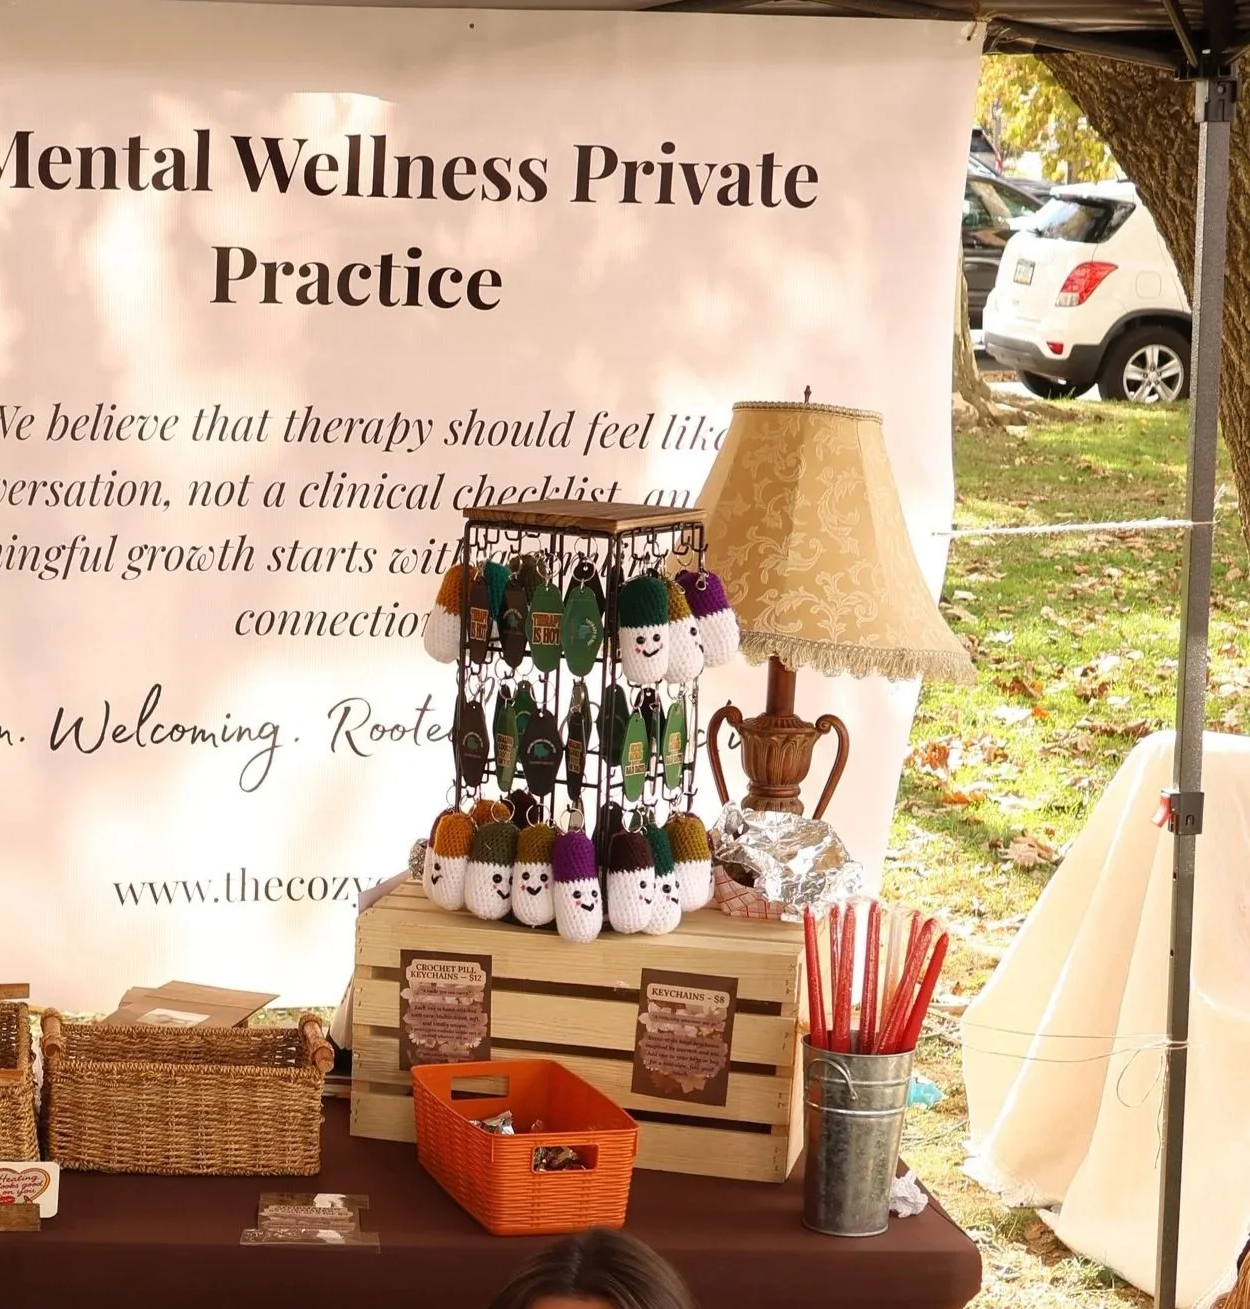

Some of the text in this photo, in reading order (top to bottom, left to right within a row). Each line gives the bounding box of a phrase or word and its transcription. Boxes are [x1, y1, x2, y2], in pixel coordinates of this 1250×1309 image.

[230, 134, 548, 203] Wellness
[570, 141, 818, 209] Private
[210, 246, 502, 311] Practice
[46, 402, 179, 441] believe
[192, 404, 272, 442] that
[284, 405, 433, 453] therapy
[444, 408, 576, 448] should
[583, 410, 655, 456] feel
[188, 474, 254, 507] not
[263, 481, 286, 508] a
[299, 470, 446, 511] clinical
[122, 534, 254, 580] growth
[267, 540, 377, 573] starts
[50, 683, 299, 793] Welcoming.
[327, 693, 454, 757] Roote
[410, 971, 459, 980] KEYCHAINS
[469, 974, 482, 982] $12
[416, 963, 477, 974] CROCHET PILL
[651, 987, 705, 1001] KEYCHAINS
[714, 994, 725, 1004] $8
[17, 1188, 36, 1198] you
[21, 1180, 44, 1191] good
